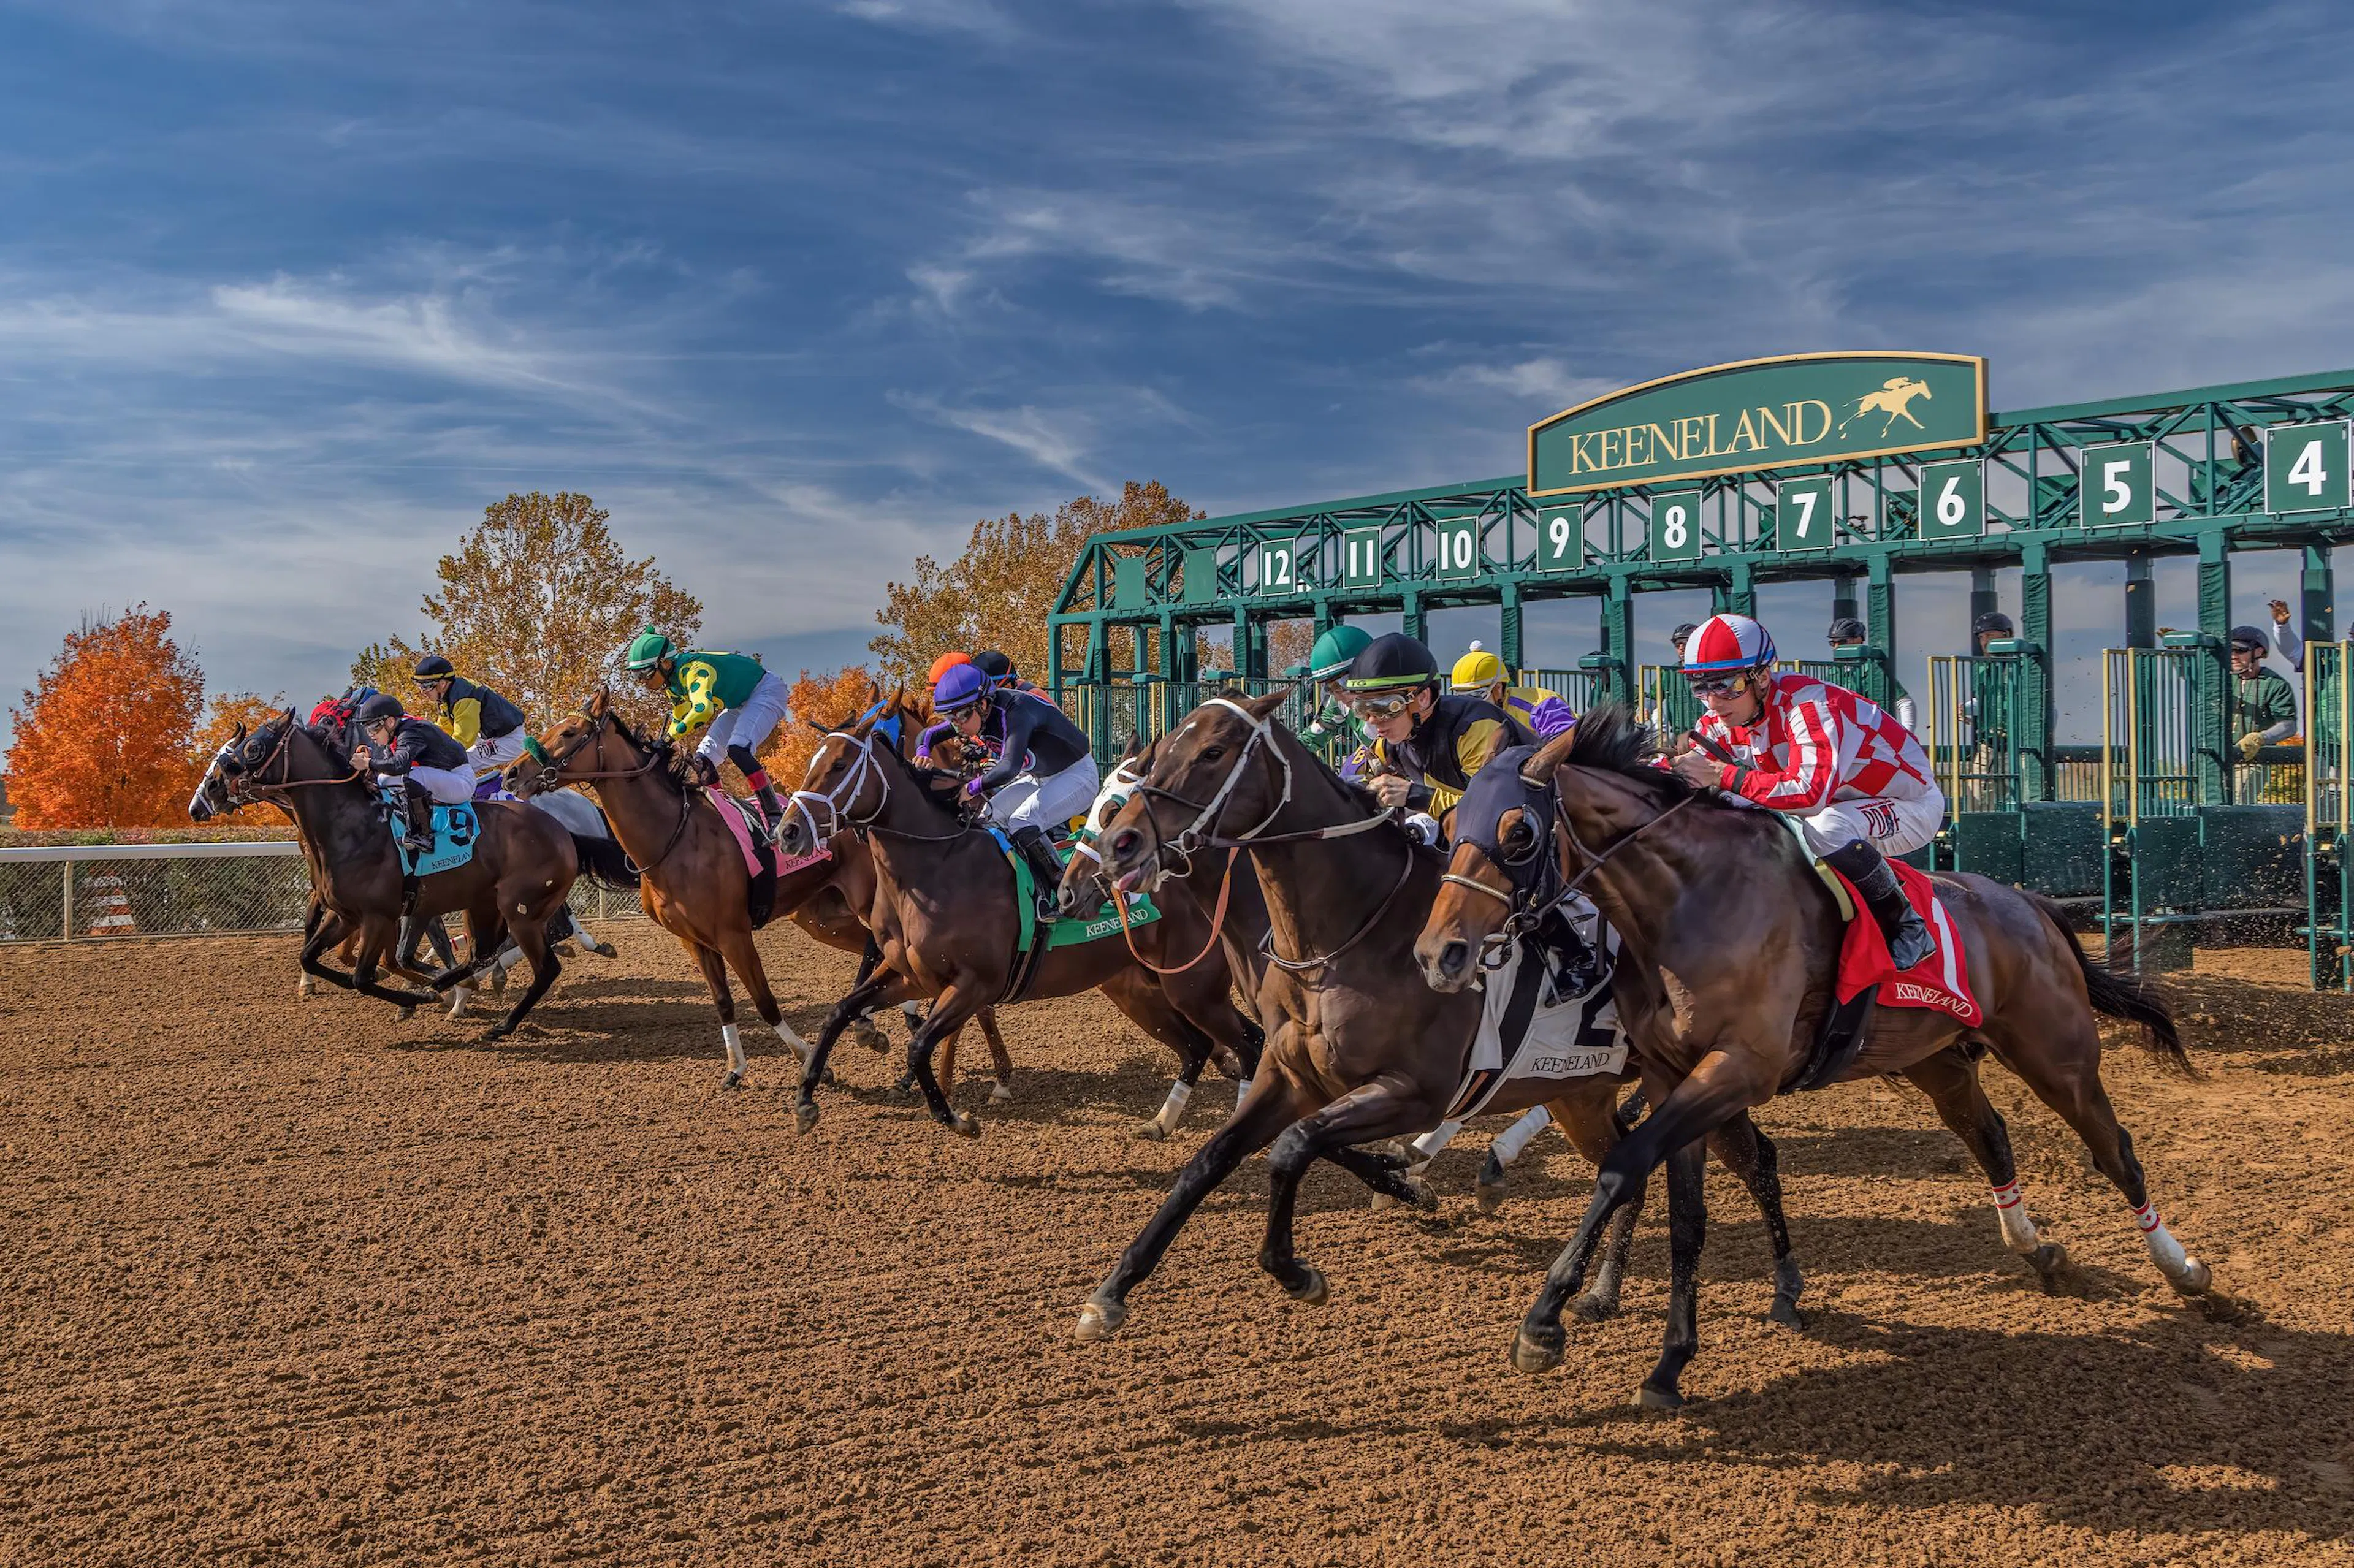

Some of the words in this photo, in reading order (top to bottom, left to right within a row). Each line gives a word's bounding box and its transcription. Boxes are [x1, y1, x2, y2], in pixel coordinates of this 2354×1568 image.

[1569, 399, 1832, 474] KEENELAND
[2102, 460, 2131, 514] 5
[2287, 440, 2327, 496] 4
[1792, 492, 1818, 538] 7
[1936, 476, 1965, 526] 6
[1548, 517, 1569, 559] 9
[1664, 505, 1687, 549] 8
[1265, 549, 1291, 586] 12
[1350, 539, 1374, 578] 11
[1441, 530, 1472, 570] 10
[449, 808, 474, 847] 9
[1932, 896, 1970, 1002] 1
[1895, 983, 1973, 1018] KEENELAND
[1530, 1052, 1609, 1072] KEENELAND
